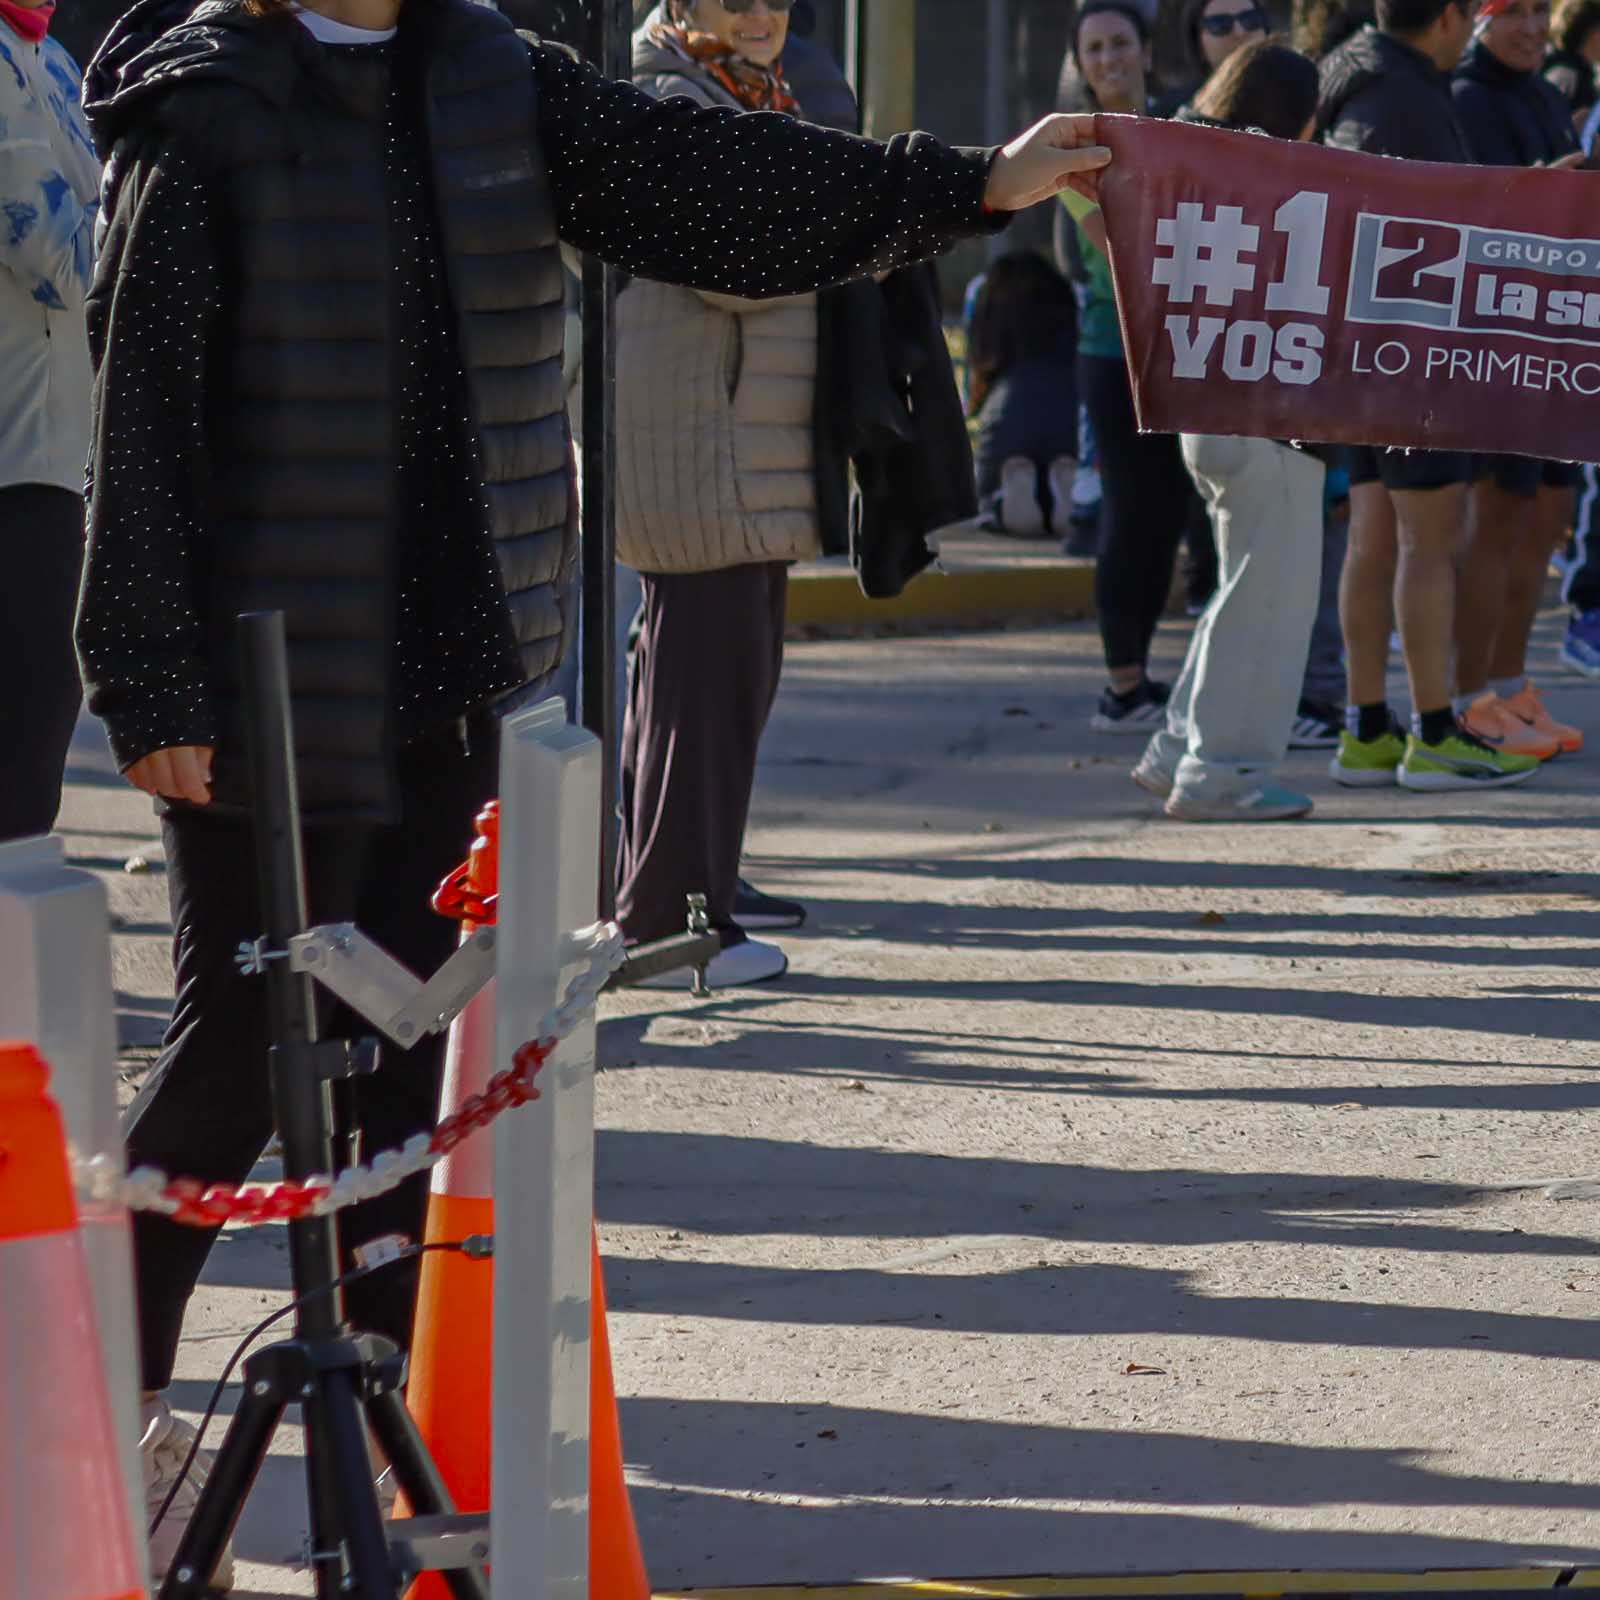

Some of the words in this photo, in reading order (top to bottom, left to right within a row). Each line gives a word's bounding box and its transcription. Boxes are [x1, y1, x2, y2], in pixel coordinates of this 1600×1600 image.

[1151, 191, 1330, 315] #1
[1481, 239, 1587, 269] GRUPO
[1475, 273, 1537, 321] La
[1165, 314, 1325, 385] VOS
[1352, 341, 1410, 376] LO
